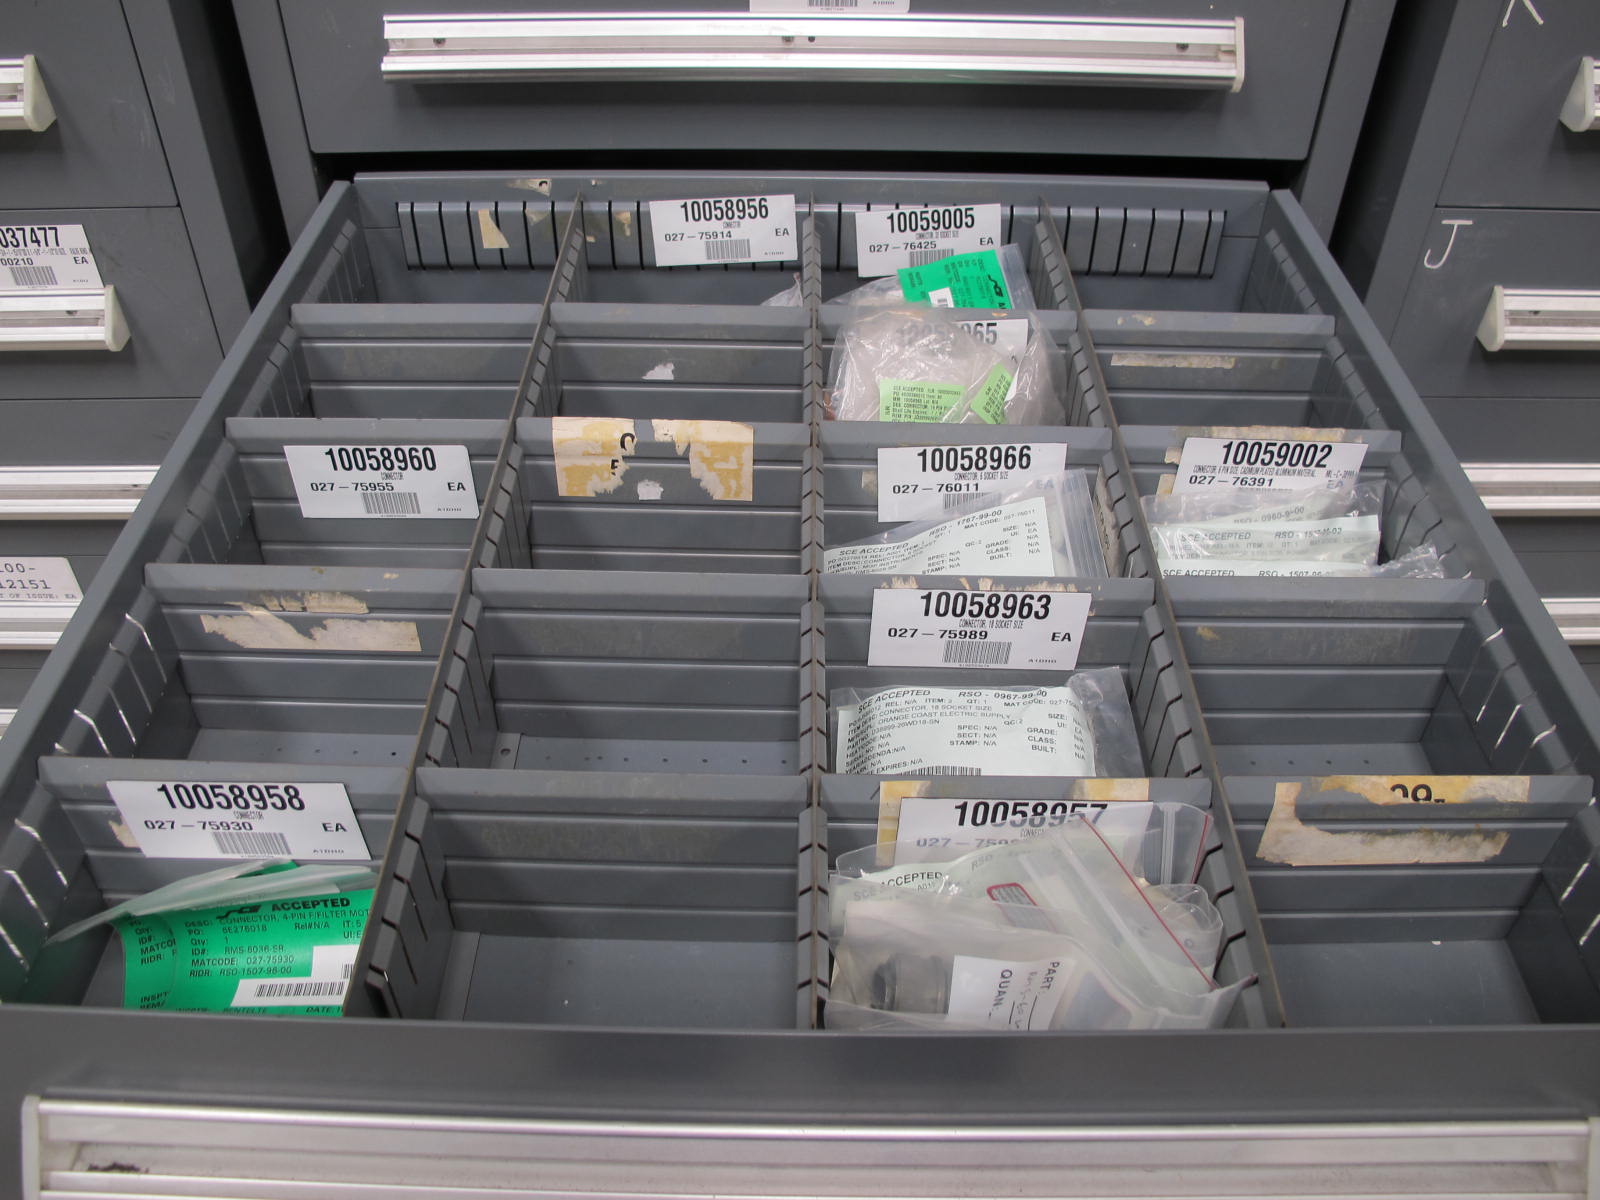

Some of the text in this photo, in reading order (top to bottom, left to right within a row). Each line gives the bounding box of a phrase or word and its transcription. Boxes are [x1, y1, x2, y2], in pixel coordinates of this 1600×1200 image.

[680, 197, 769, 222] 10058956
[887, 207, 975, 233] 10059005
[775, 228, 790, 237] EA
[980, 237, 994, 246] EA
[74, 256, 89, 265] EA
[325, 446, 437, 472] 10058960
[917, 445, 1031, 473] 10058966
[1222, 440, 1333, 469] 10059002
[447, 482, 466, 492] EA
[1326, 480, 1344, 489] EA
[1274, 530, 1294, 539] RSO
[859, 542, 909, 555] ACCEPTED
[0, 563, 36, 573] 00-
[1184, 569, 1235, 577] ACCEPTED
[920, 591, 1052, 620] 10058963
[995, 619, 1013, 628] SOCKET
[1013, 620, 1024, 629] SIZE
[1051, 631, 1072, 642] EA
[858, 698, 873, 714] SCE
[874, 689, 931, 704] ACCEPTED
[878, 714, 910, 724] ORANGE
[980, 711, 1012, 719] SUPPLY
[879, 732, 892, 741] N/A
[1048, 713, 1068, 721] SIZE:
[877, 741, 890, 750] N/A
[1027, 727, 1058, 736] GRADE:
[1027, 735, 1057, 745] CLASS:
[870, 744, 1086, 767] N/A BUILT: N/A
[910, 758, 923, 766] N/A
[157, 783, 306, 812] 10058958
[954, 800, 1108, 828] 10058957
[321, 822, 347, 833] EA
[271, 897, 351, 912] ACCEPTED
[218, 914, 280, 926] CONNECTOR,
[190, 938, 208, 946] Qty:
[191, 957, 239, 967] MATCODE:
[246, 954, 295, 965] 027-75930
